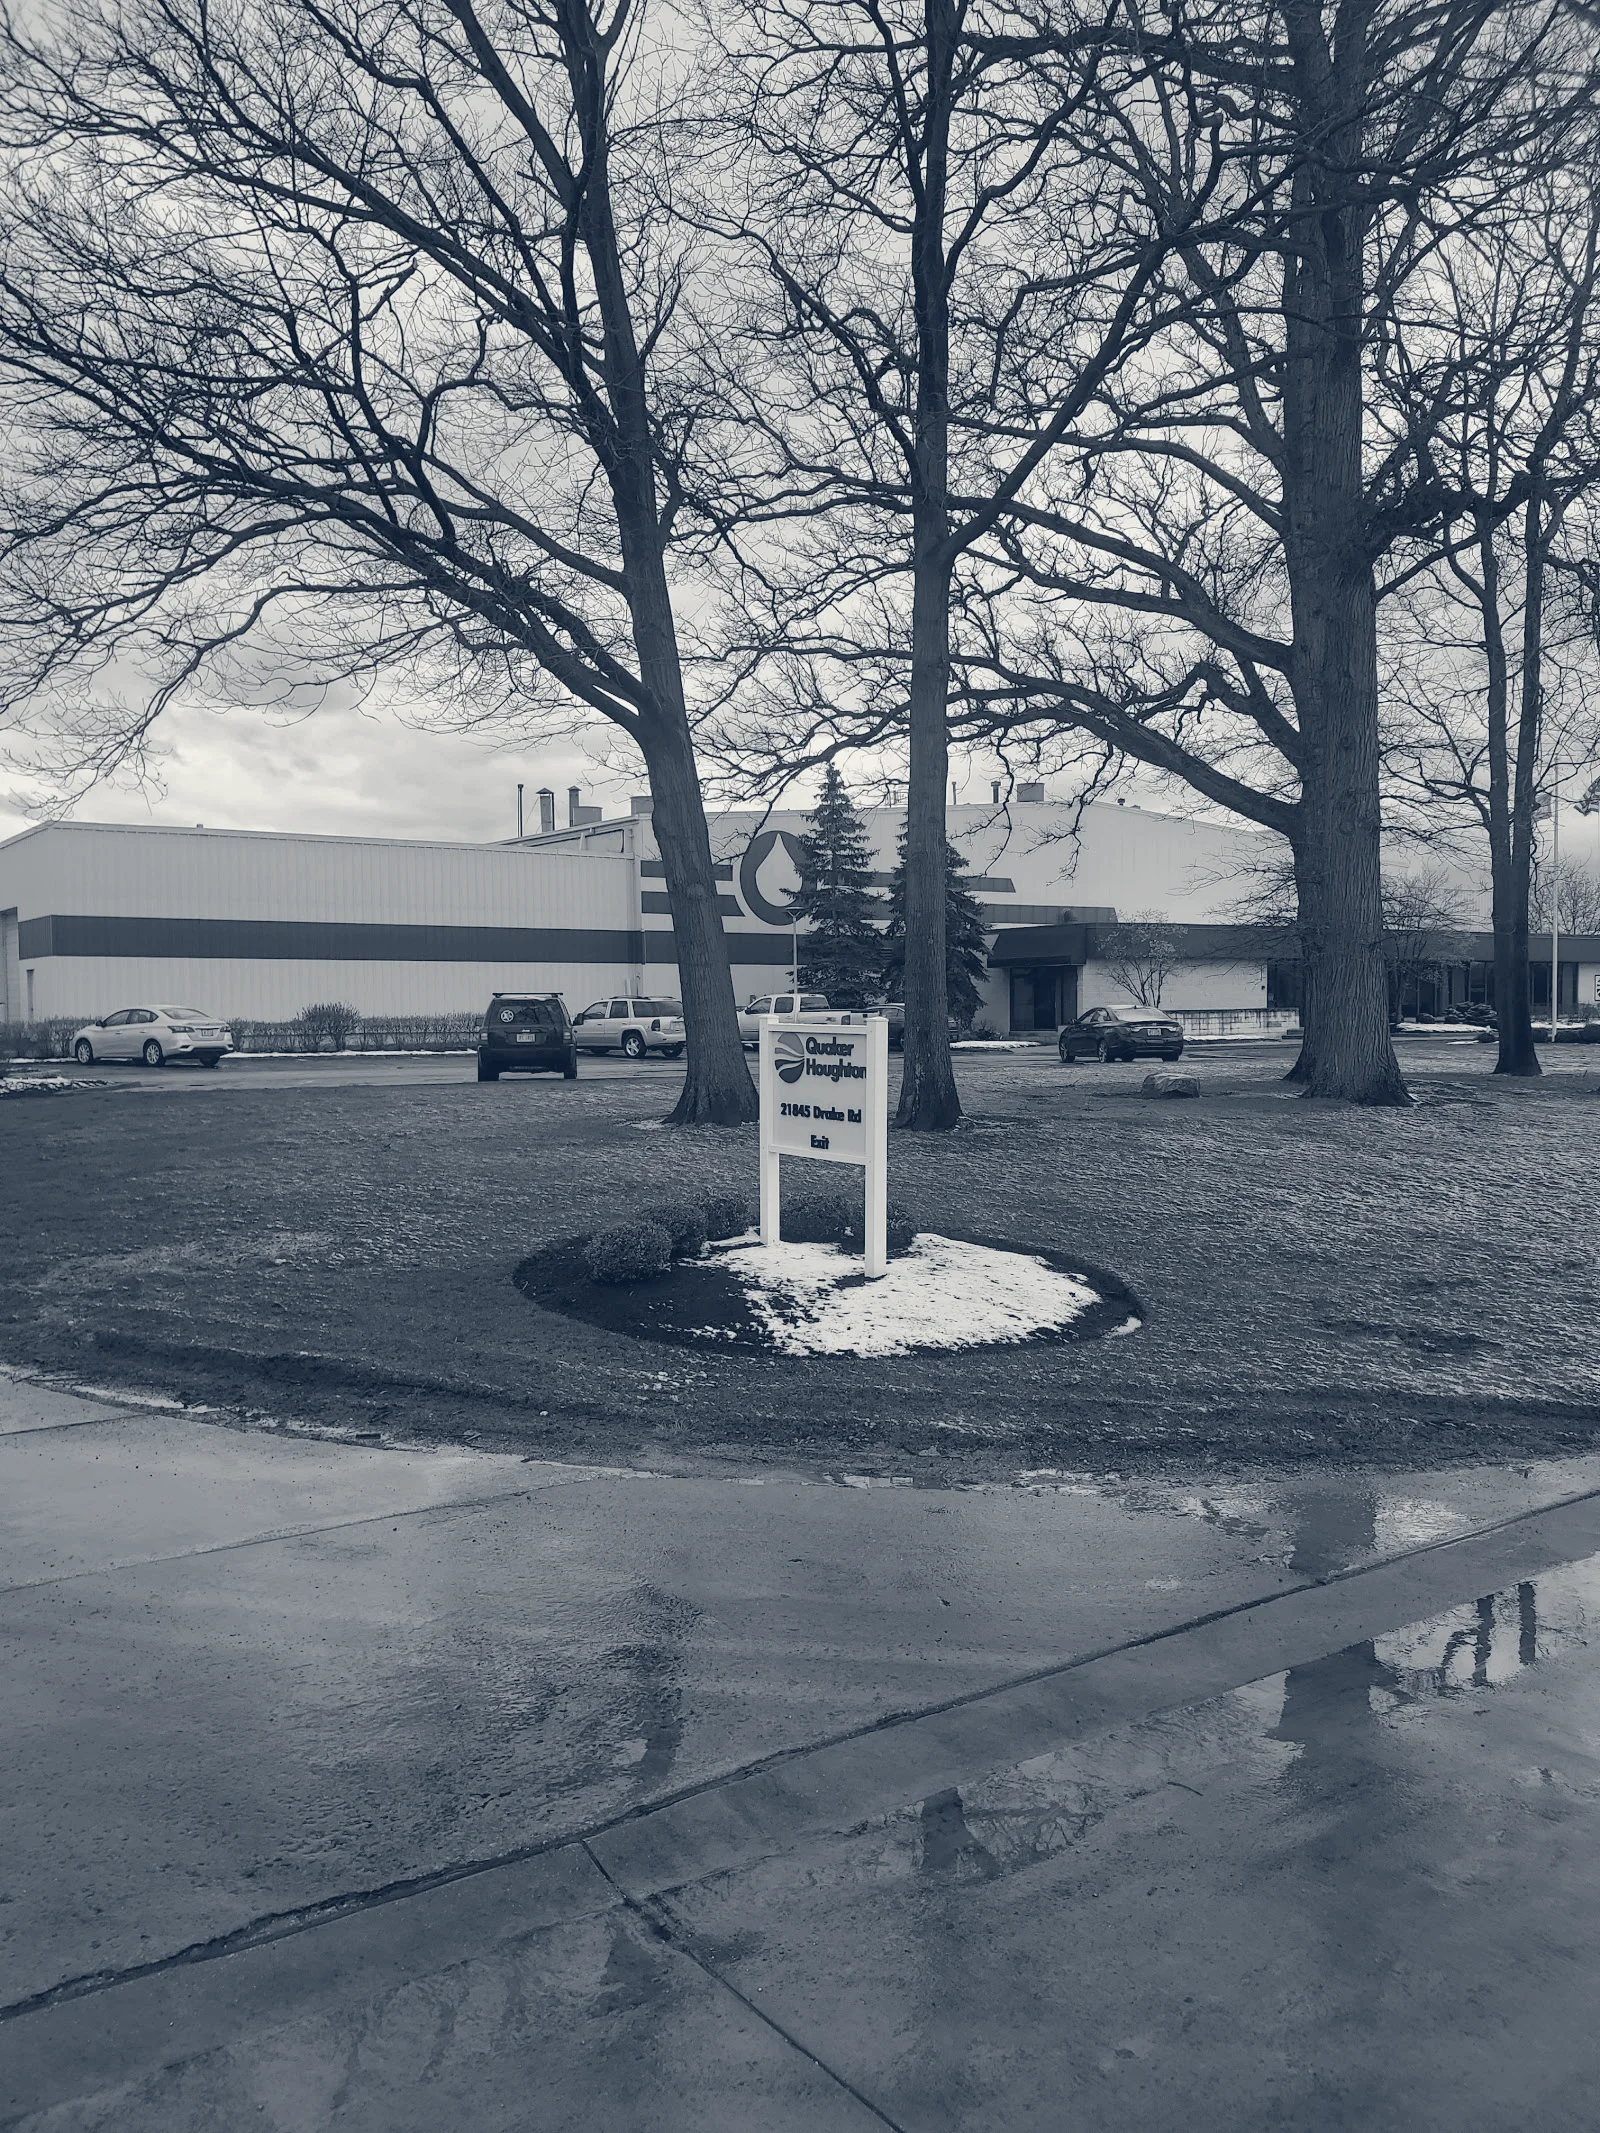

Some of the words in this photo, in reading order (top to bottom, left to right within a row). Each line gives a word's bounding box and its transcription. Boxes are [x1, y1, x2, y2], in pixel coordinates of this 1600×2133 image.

[806, 1036, 854, 1056] Quaker
[806, 1058, 867, 1082] Houghton
[780, 1102, 811, 1118] 21845
[813, 1105, 845, 1122] Drake
[848, 1108, 862, 1124] Rd
[810, 1134, 830, 1150] Exit
